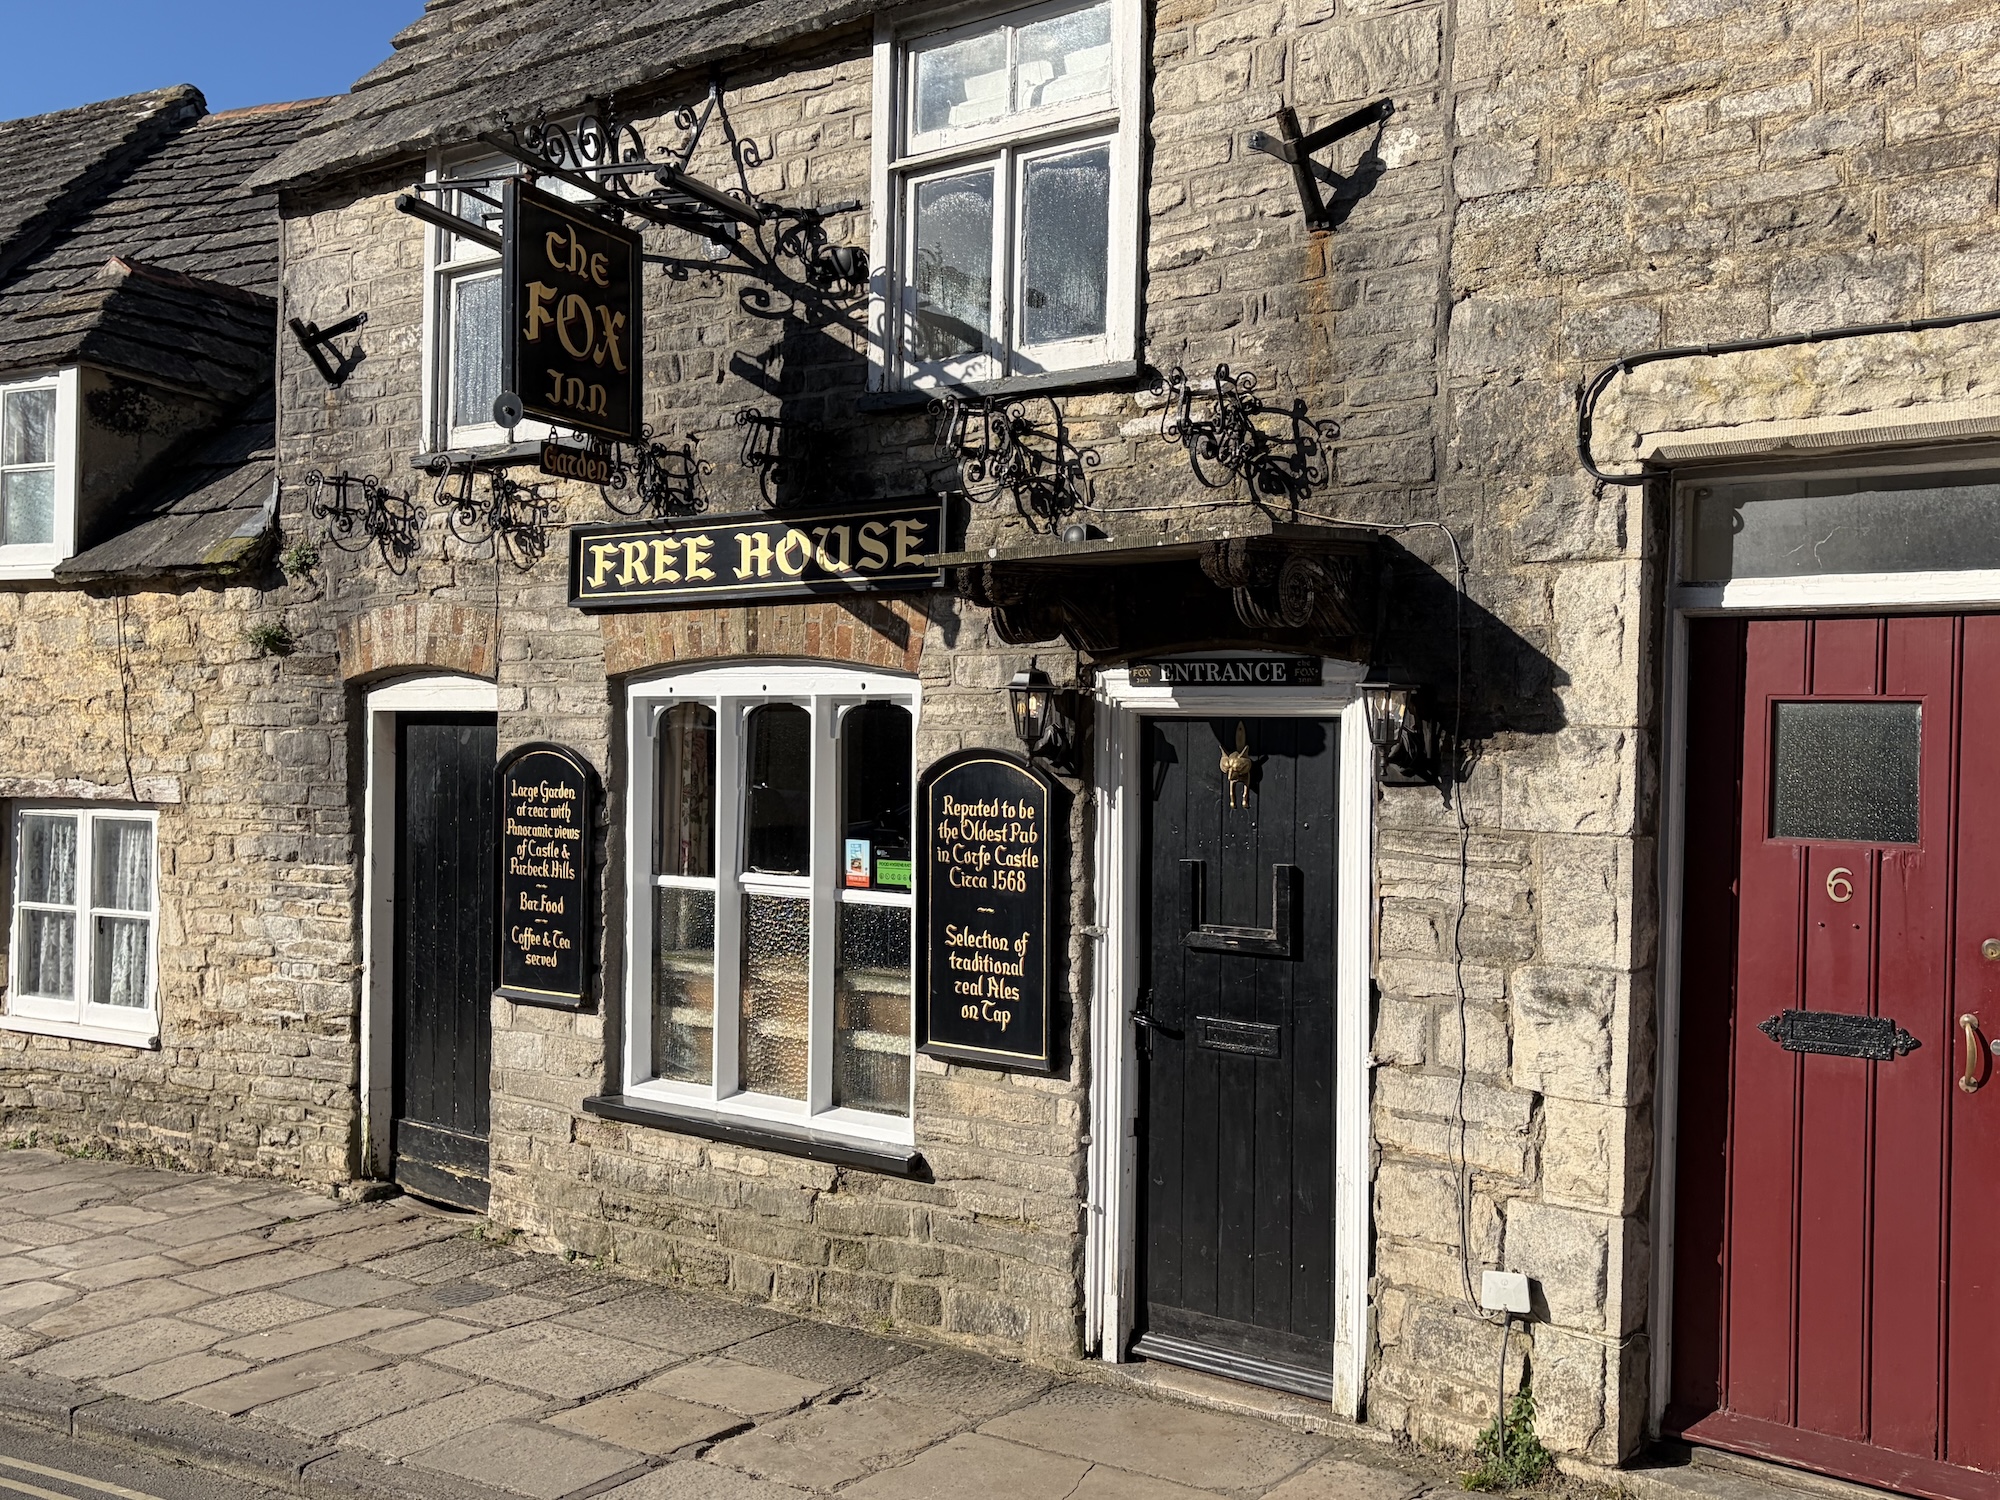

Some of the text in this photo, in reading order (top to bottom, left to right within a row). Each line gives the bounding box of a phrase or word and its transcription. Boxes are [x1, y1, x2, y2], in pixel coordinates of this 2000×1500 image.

[523, 280, 627, 371] FOX
[546, 368, 608, 417] Inn
[544, 446, 608, 482] Garden
[587, 518, 928, 588] FREE HOUSE
[1132, 668, 1152, 677] FOX
[1159, 662, 1287, 682] ENTRANCE
[1294, 667, 1315, 677] FOX
[511, 778, 576, 803] Large Garden
[516, 801, 572, 823] at rear with
[942, 794, 1035, 823] Reputed to be
[506, 817, 581, 840] Panoramic views
[937, 818, 1039, 845] the Oldest Pub
[516, 838, 571, 860] of Castle &
[937, 843, 1040, 872] in Corfe Castle
[509, 857, 576, 880] Purbeck Hills
[949, 866, 1027, 893] Circa 1568
[1826, 867, 1853, 903] 6
[519, 891, 564, 915] Bar Food
[511, 925, 571, 951] Coffee & Tea
[944, 923, 1030, 957] Selection of
[524, 950, 558, 968] served
[948, 950, 1025, 977] traditional
[953, 974, 1020, 1002] real Ales
[961, 999, 1012, 1032] on Tap
